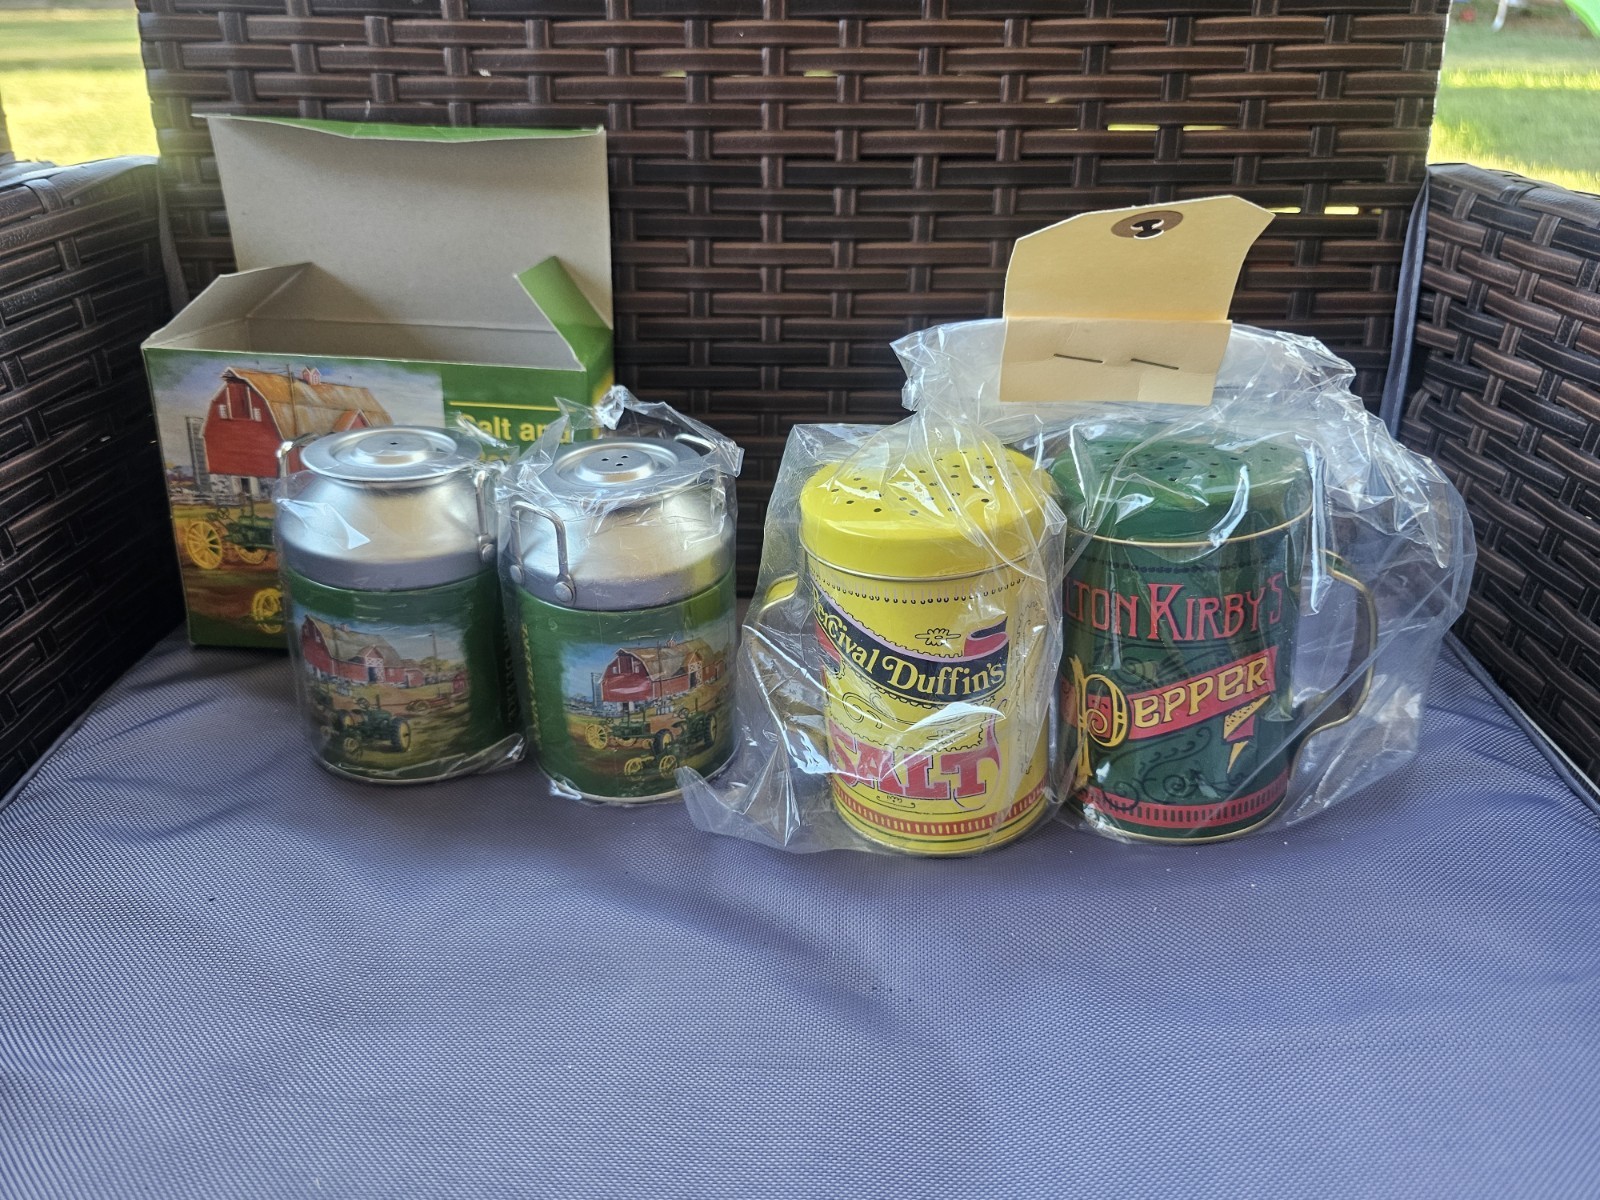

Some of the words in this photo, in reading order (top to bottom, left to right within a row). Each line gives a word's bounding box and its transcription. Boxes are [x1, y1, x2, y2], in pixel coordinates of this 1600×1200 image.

[1147, 571, 1284, 641] KIRBY'S
[881, 655, 1005, 697] Duffin's
[827, 716, 1002, 806] SALT
